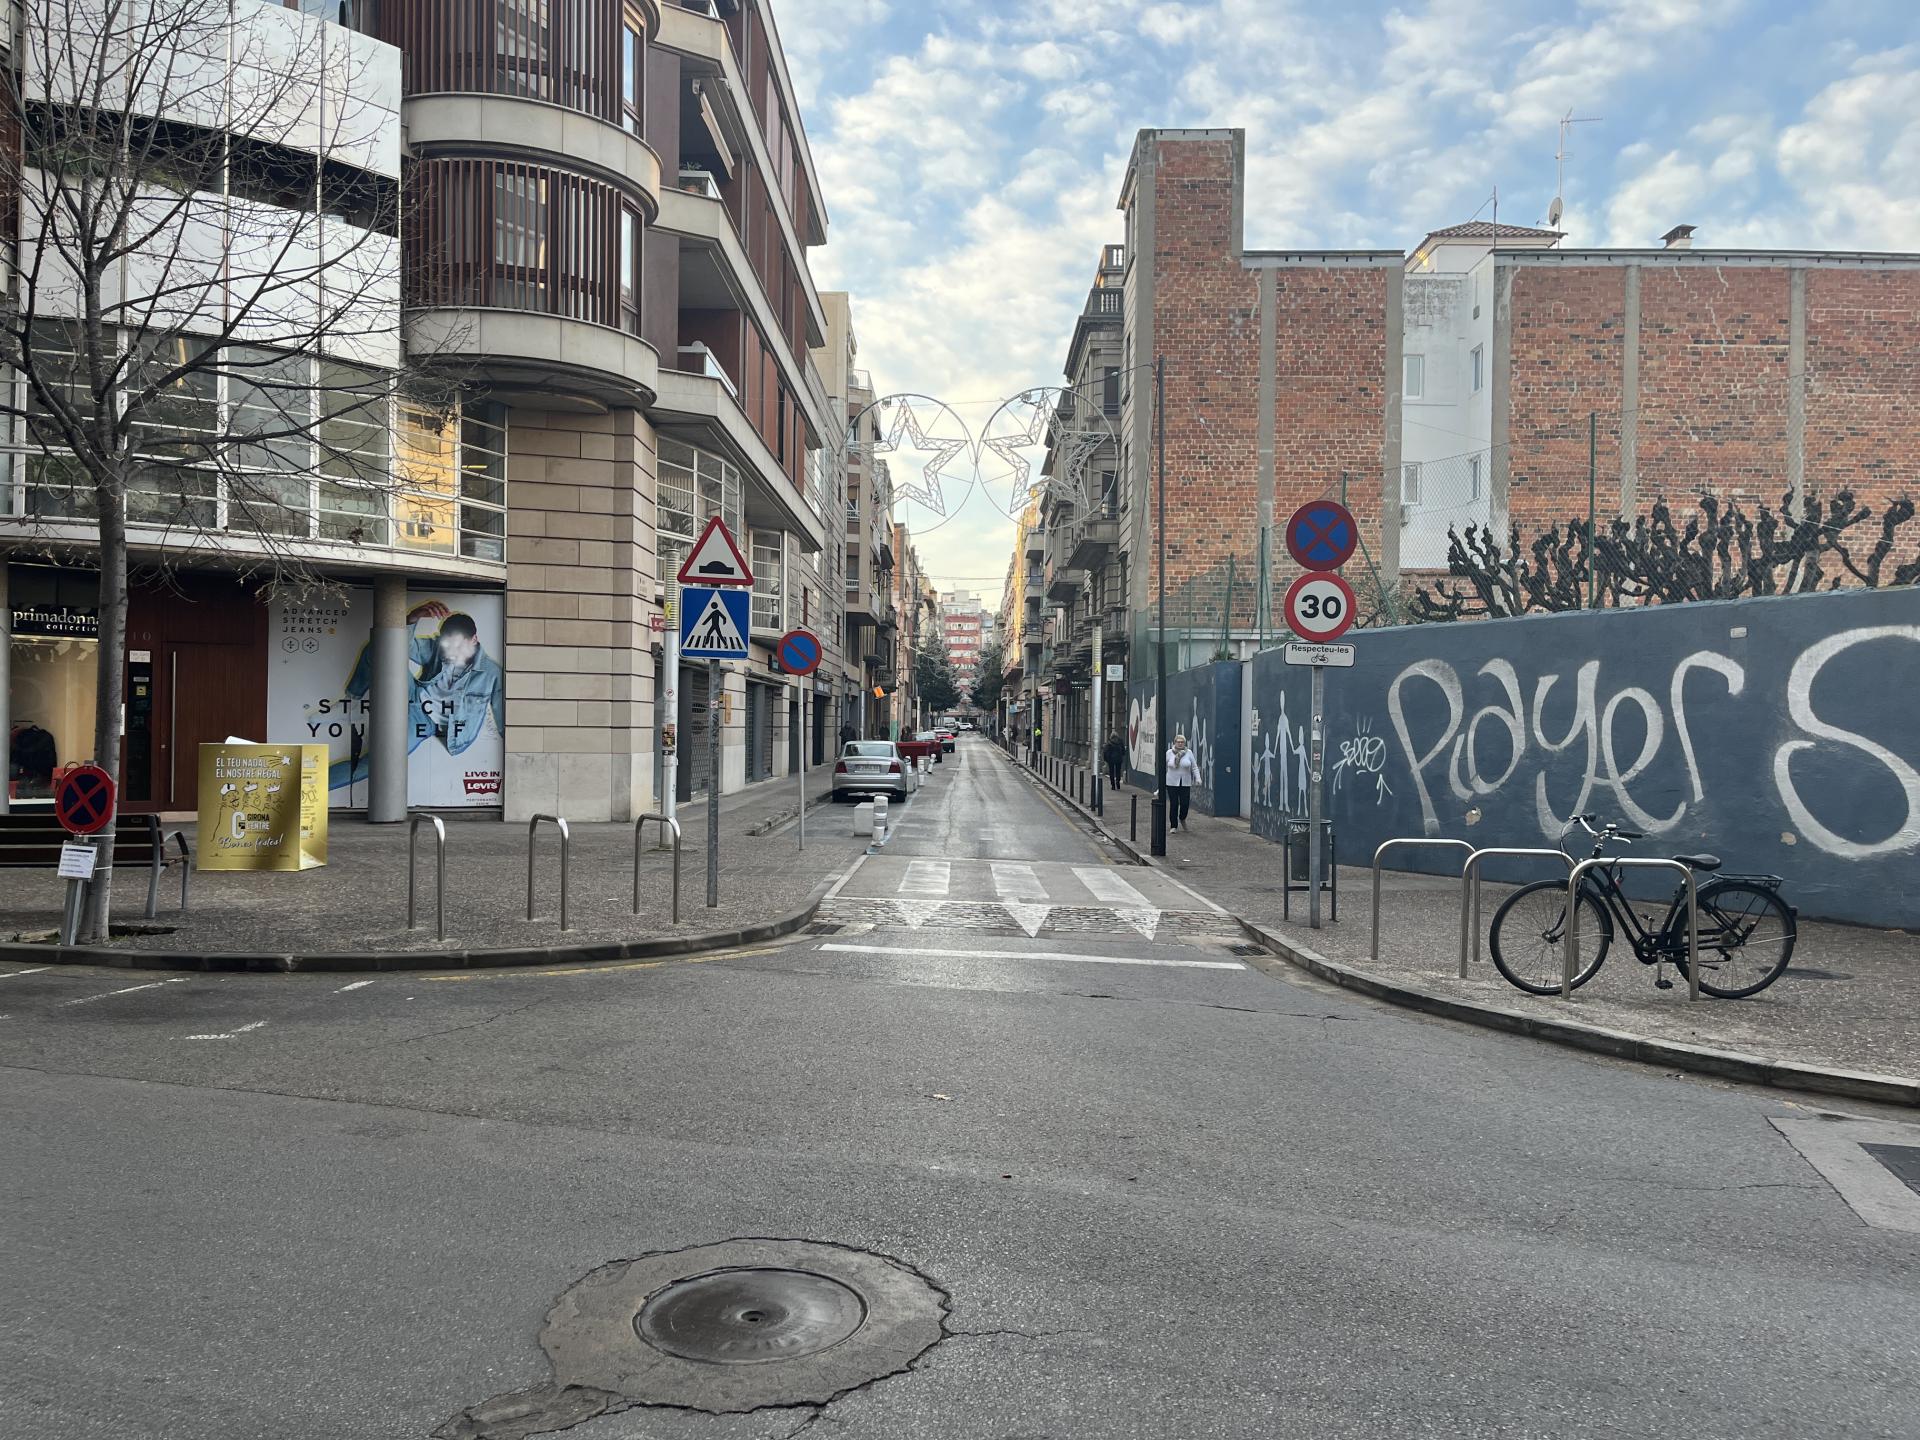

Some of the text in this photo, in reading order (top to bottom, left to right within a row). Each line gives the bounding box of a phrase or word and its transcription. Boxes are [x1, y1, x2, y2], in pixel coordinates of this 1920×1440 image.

[1301, 594, 1341, 619] 30
[283, 617, 337, 625] STRETCH
[46, 623, 97, 632] collectio
[282, 626, 322, 634] JEANS
[1291, 644, 1349, 654] Respecteu-les
[318, 699, 454, 715] STRCH
[307, 722, 466, 738] YOUELF
[216, 757, 267, 768] EL TEU NADAL
[216, 768, 281, 779] EL NOSTRE REGAL
[247, 813, 270, 821] GIRONA
[246, 821, 270, 830] CENTRE
